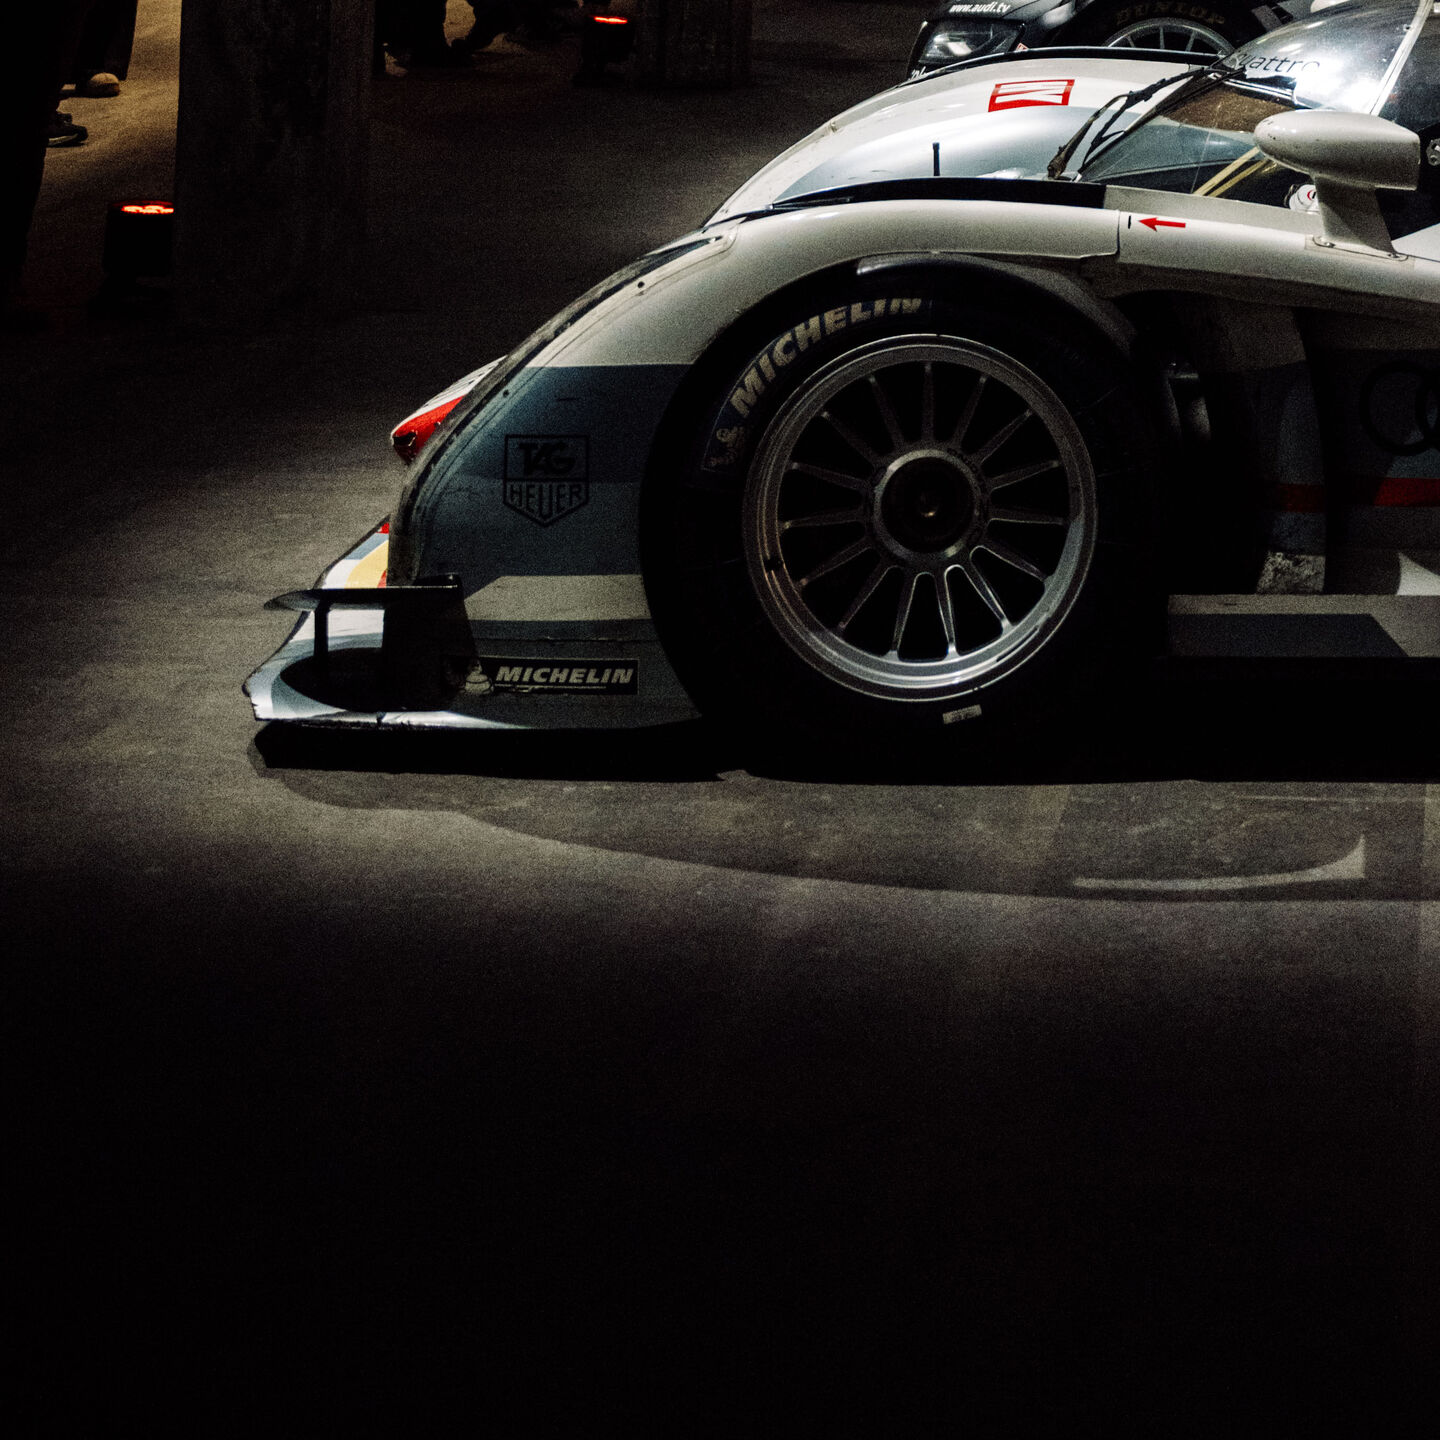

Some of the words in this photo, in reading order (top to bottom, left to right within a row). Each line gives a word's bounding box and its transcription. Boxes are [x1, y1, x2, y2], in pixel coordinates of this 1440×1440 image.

[948, 1, 1012, 13] www.audi.tv
[731, 297, 923, 417] MICHELIN
[519, 441, 575, 475] TAG
[510, 484, 581, 519] HEUER
[496, 666, 634, 684] MICHELIN
